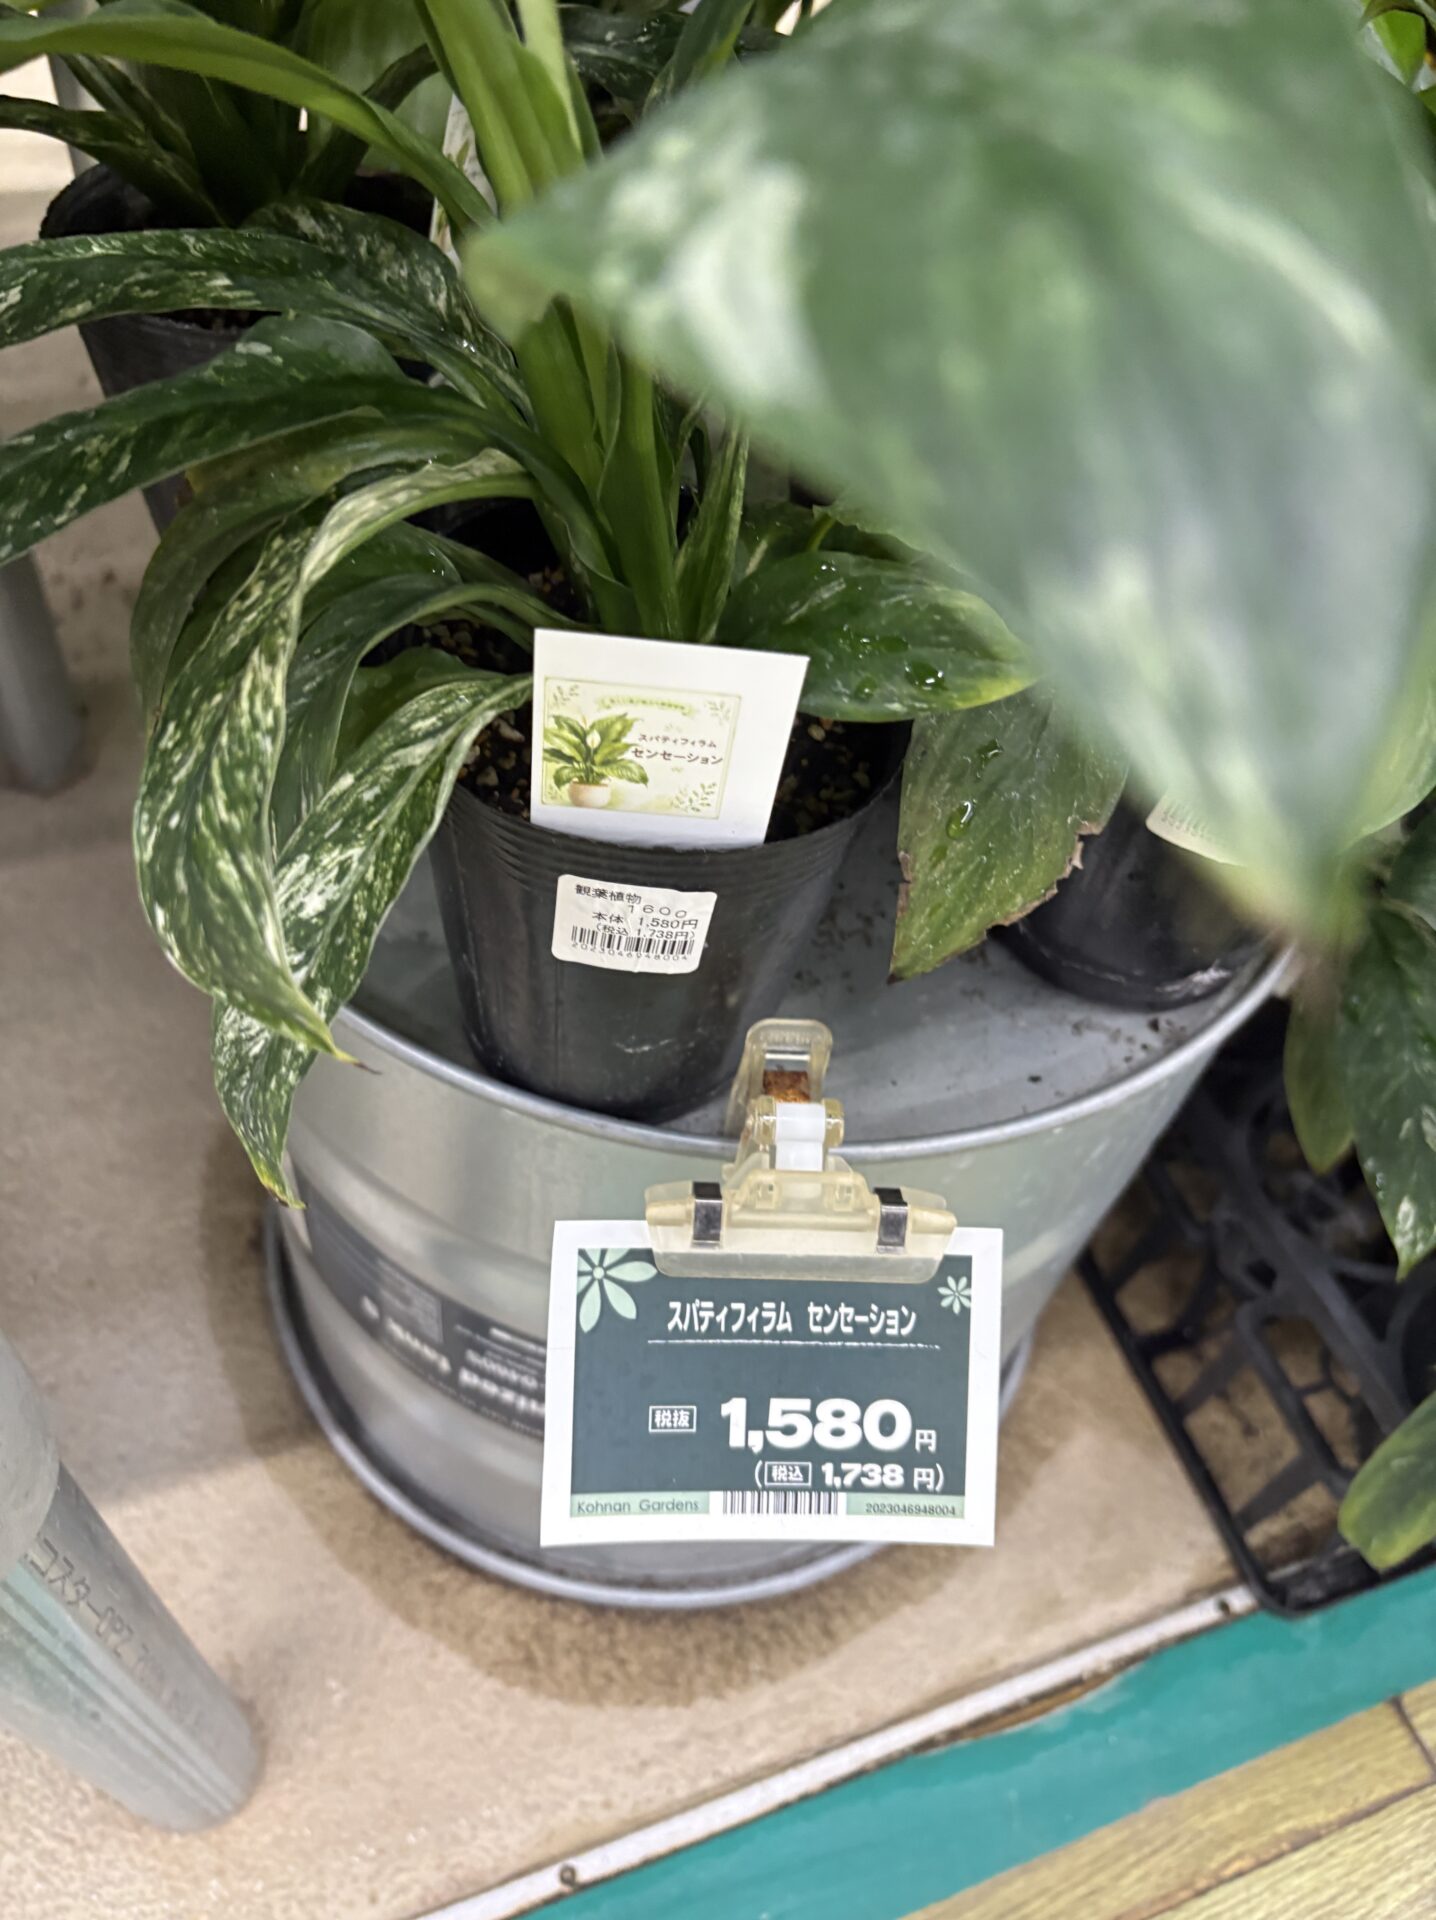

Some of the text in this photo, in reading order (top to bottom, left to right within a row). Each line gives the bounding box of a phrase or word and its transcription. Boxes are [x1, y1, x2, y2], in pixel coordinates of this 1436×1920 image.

[632, 747, 723, 765] センセーション
[574, 884, 642, 905] 観葉植物
[592, 911, 624, 924] 本体
[667, 1298, 917, 1335] スパティフィラム センセーション
[654, 1409, 690, 1428] 税抜
[577, 1498, 699, 1514] Kohnan Gardens
[865, 1502, 956, 1516] 2023046948004
